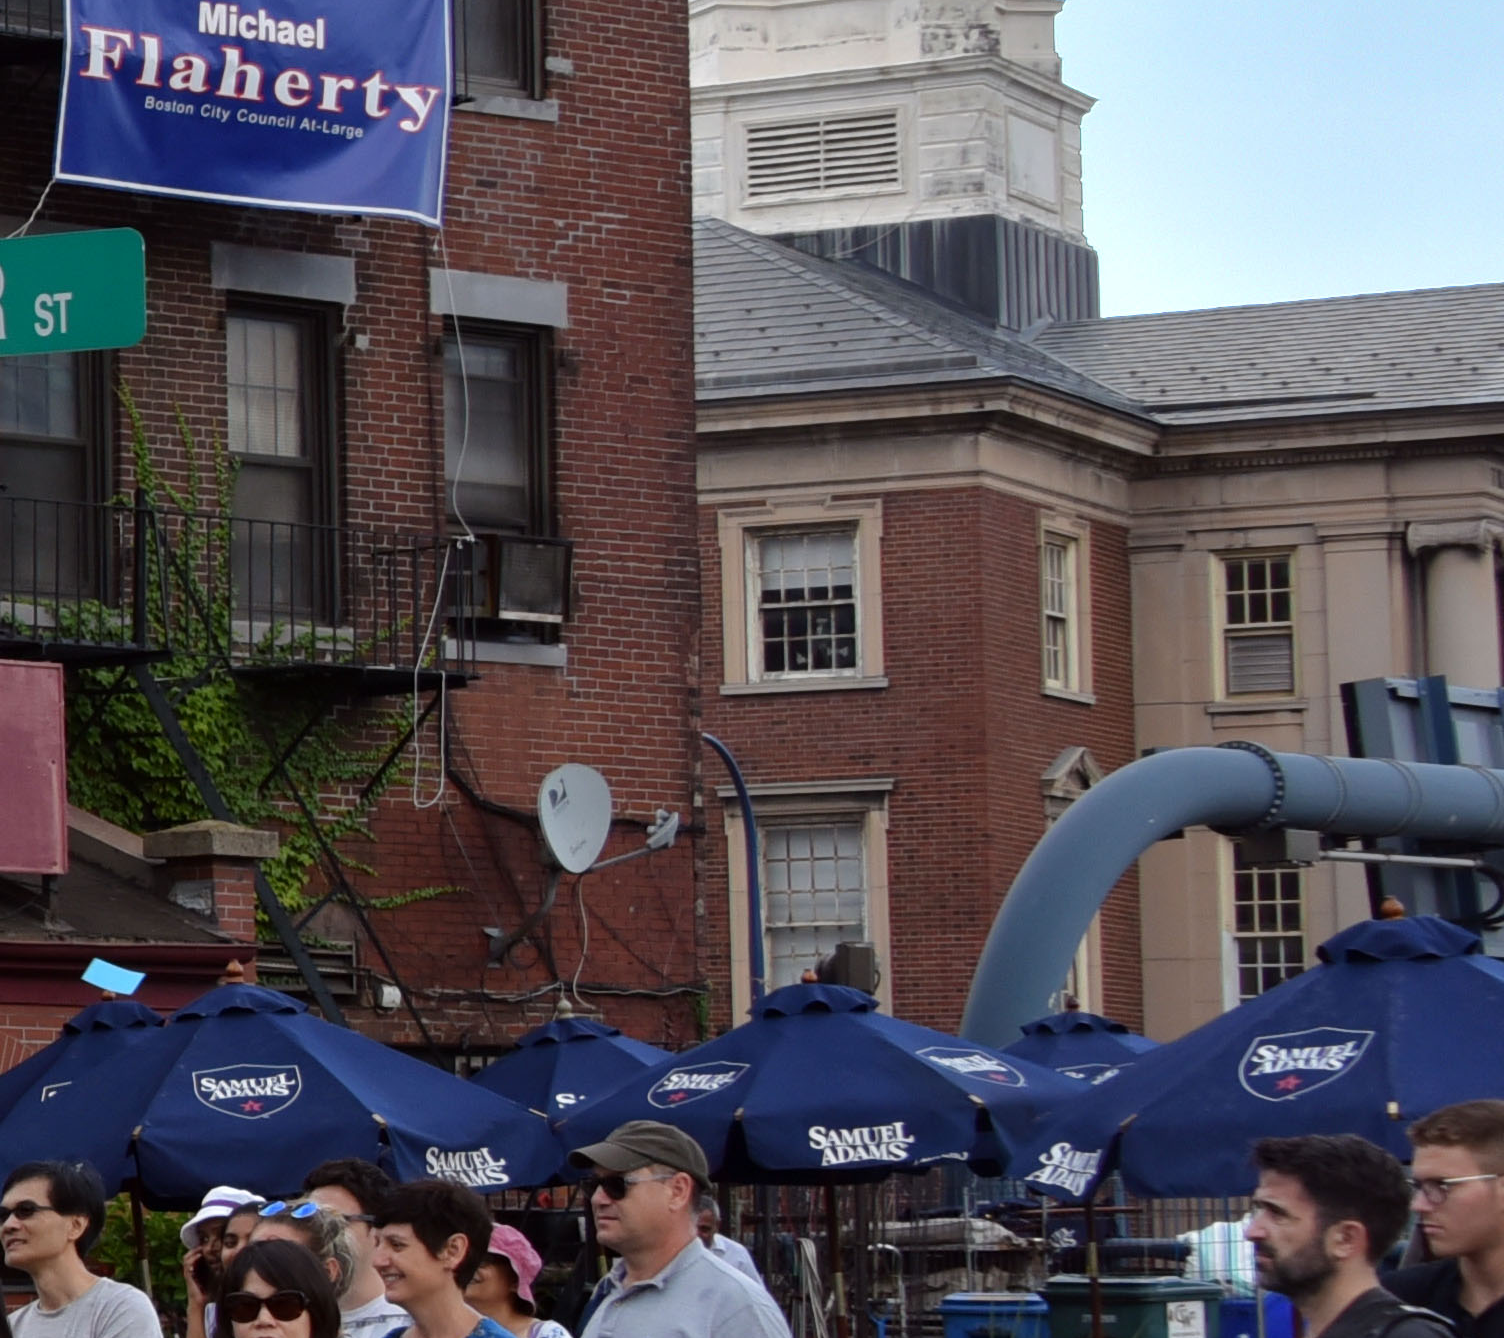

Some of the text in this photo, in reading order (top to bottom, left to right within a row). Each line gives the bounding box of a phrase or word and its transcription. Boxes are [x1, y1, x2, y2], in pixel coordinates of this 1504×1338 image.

[198, 0, 326, 50] Michael
[79, 22, 442, 135] Flaherty
[144, 95, 364, 140] Boston City Council At-Large
[33, 292, 73, 337] ST
[1249, 1054, 1344, 1076] ADAMS
[1251, 1040, 1359, 1063] SAMUEL
[198, 1071, 297, 1097] SAMUEL
[207, 1083, 292, 1103] ADAMS
[809, 1121, 916, 1150] SAMUEL
[425, 1146, 507, 1175] SAMUEL
[821, 1142, 916, 1167] ADAMS
